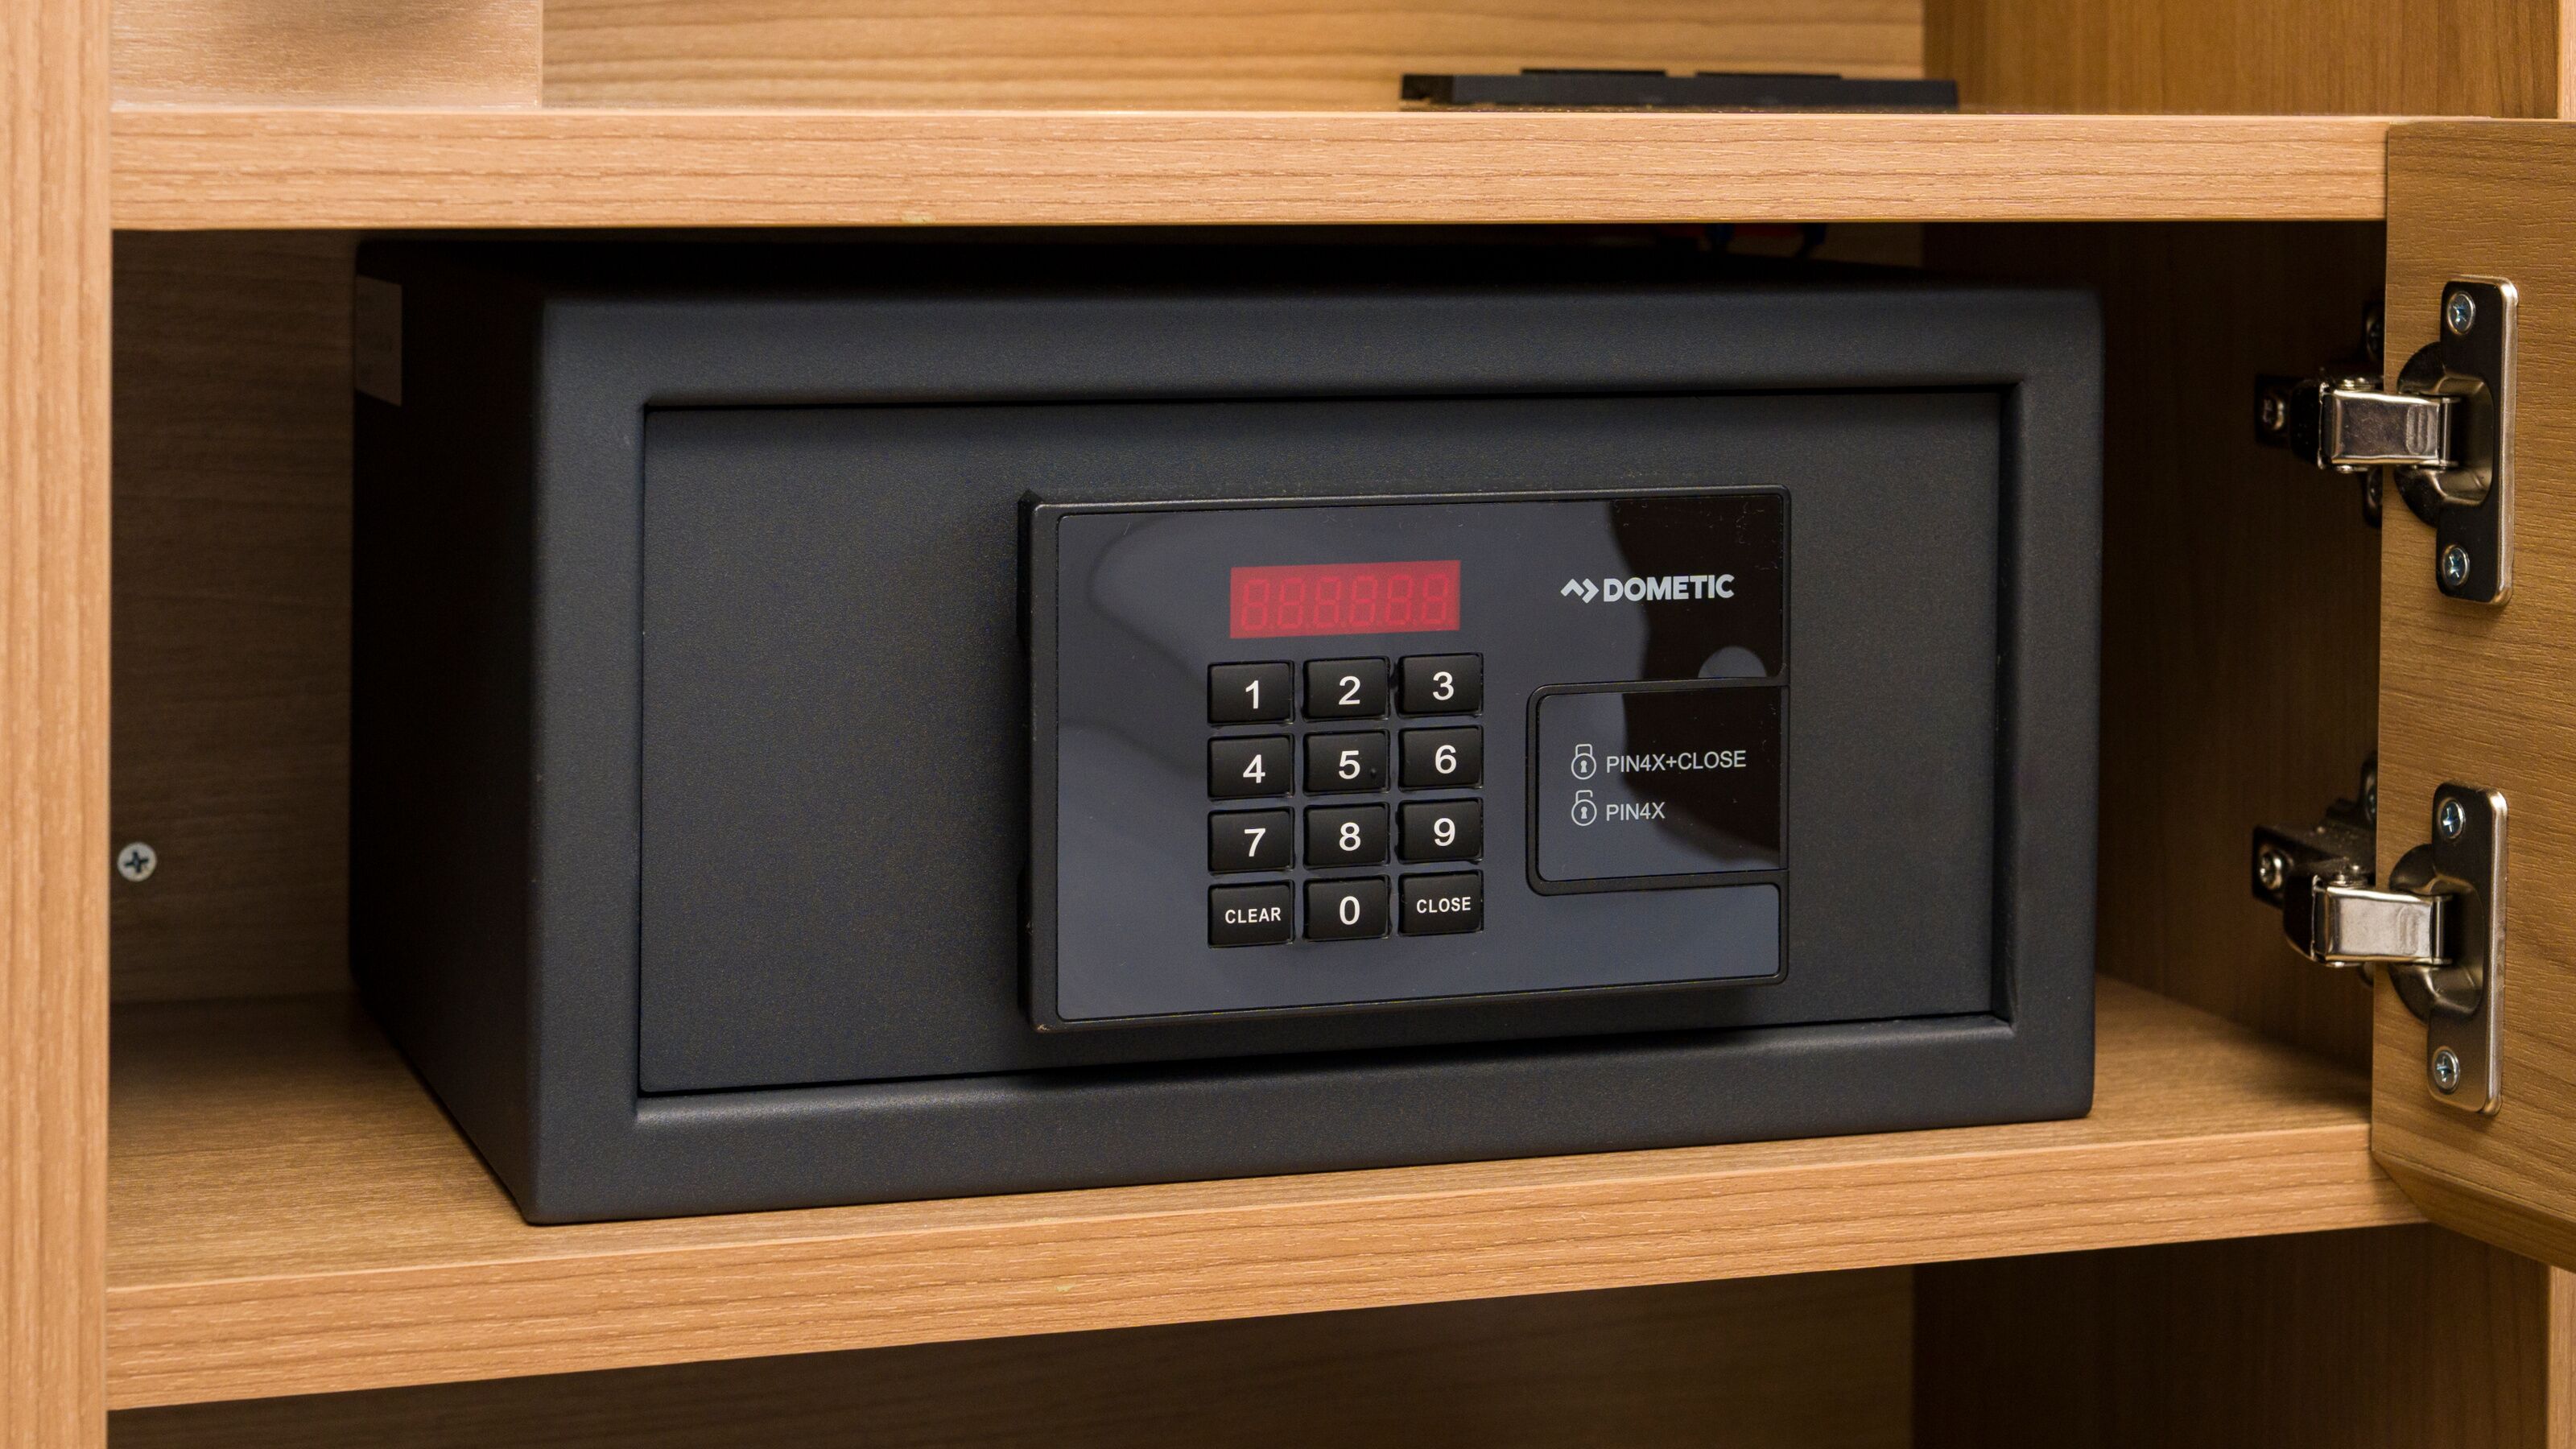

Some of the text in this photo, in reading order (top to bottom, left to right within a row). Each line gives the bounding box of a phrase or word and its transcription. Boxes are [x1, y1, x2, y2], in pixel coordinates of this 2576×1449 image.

[1603, 574, 1735, 602] DOMETIC
[1245, 679, 1259, 709] 1
[1338, 675, 1361, 705] 2
[1432, 671, 1455, 701] 3
[1242, 753, 1266, 784] 4
[1338, 749, 1360, 780] 5
[1435, 744, 1457, 774] 6
[1606, 750, 1746, 774] PIN4X+CLOSE
[1606, 802, 1666, 822] PIN4X
[1244, 828, 1266, 857] 7
[1339, 821, 1361, 852] 8
[1433, 817, 1456, 847] 9
[1224, 906, 1282, 924] CLEAR
[1339, 895, 1360, 926] 0
[1416, 896, 1472, 914] CLOSE
